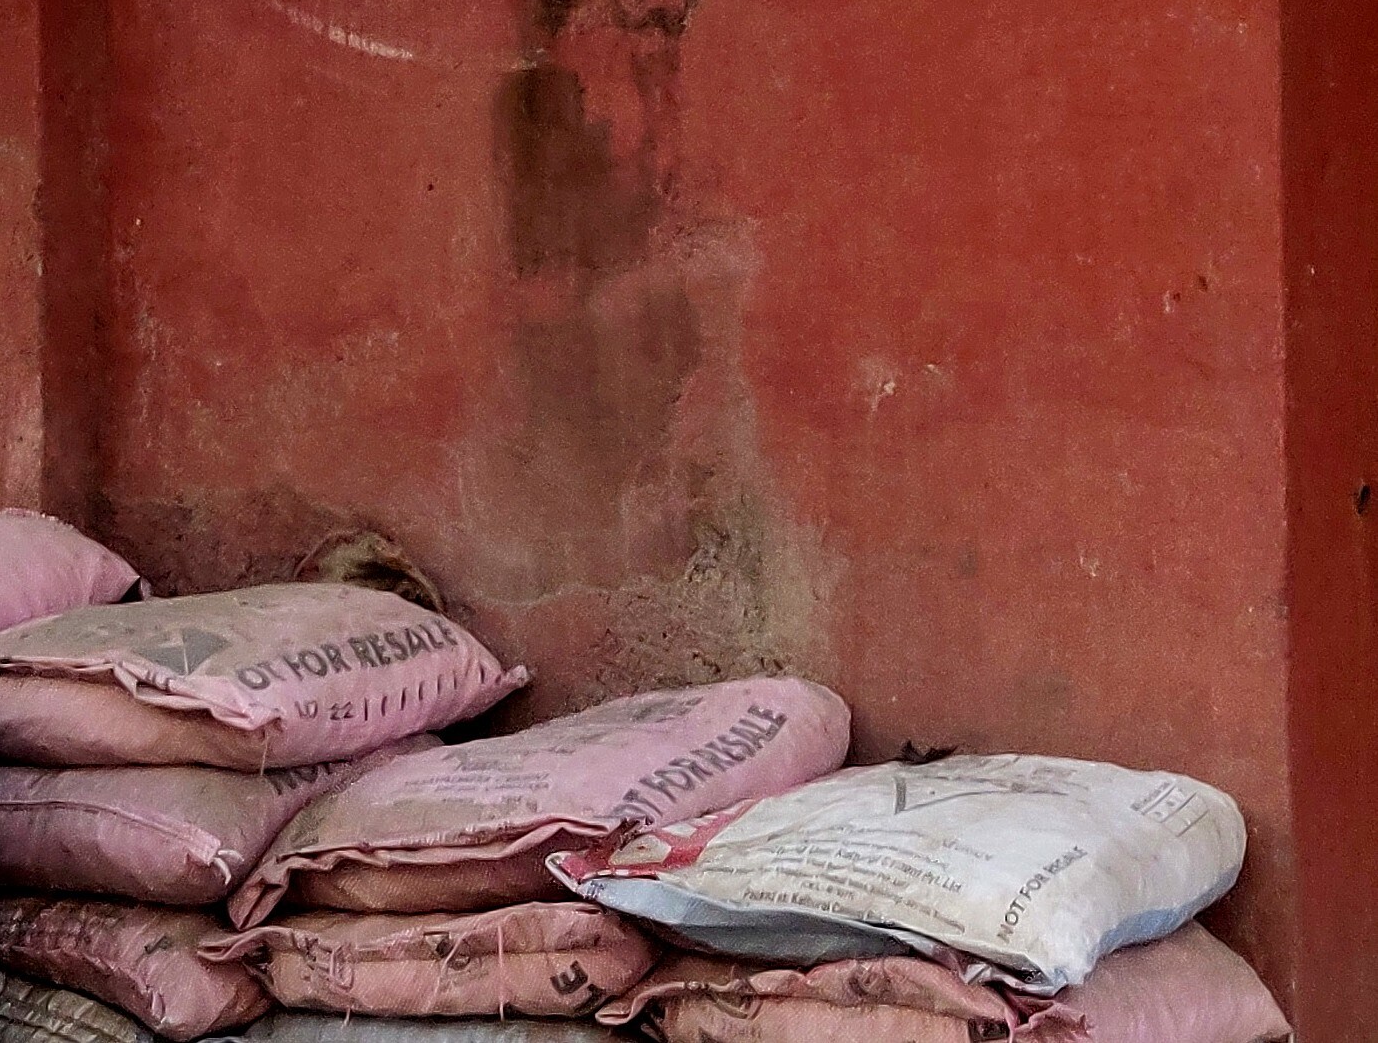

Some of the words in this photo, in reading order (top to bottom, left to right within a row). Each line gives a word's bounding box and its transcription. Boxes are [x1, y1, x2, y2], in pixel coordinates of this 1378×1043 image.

[283, 644, 352, 682] FOR
[348, 618, 459, 669] RESALE
[638, 758, 714, 804] FOR
[689, 705, 789, 773] RESALE
[996, 899, 1026, 944] NOT
[1019, 869, 1050, 900] FOR
